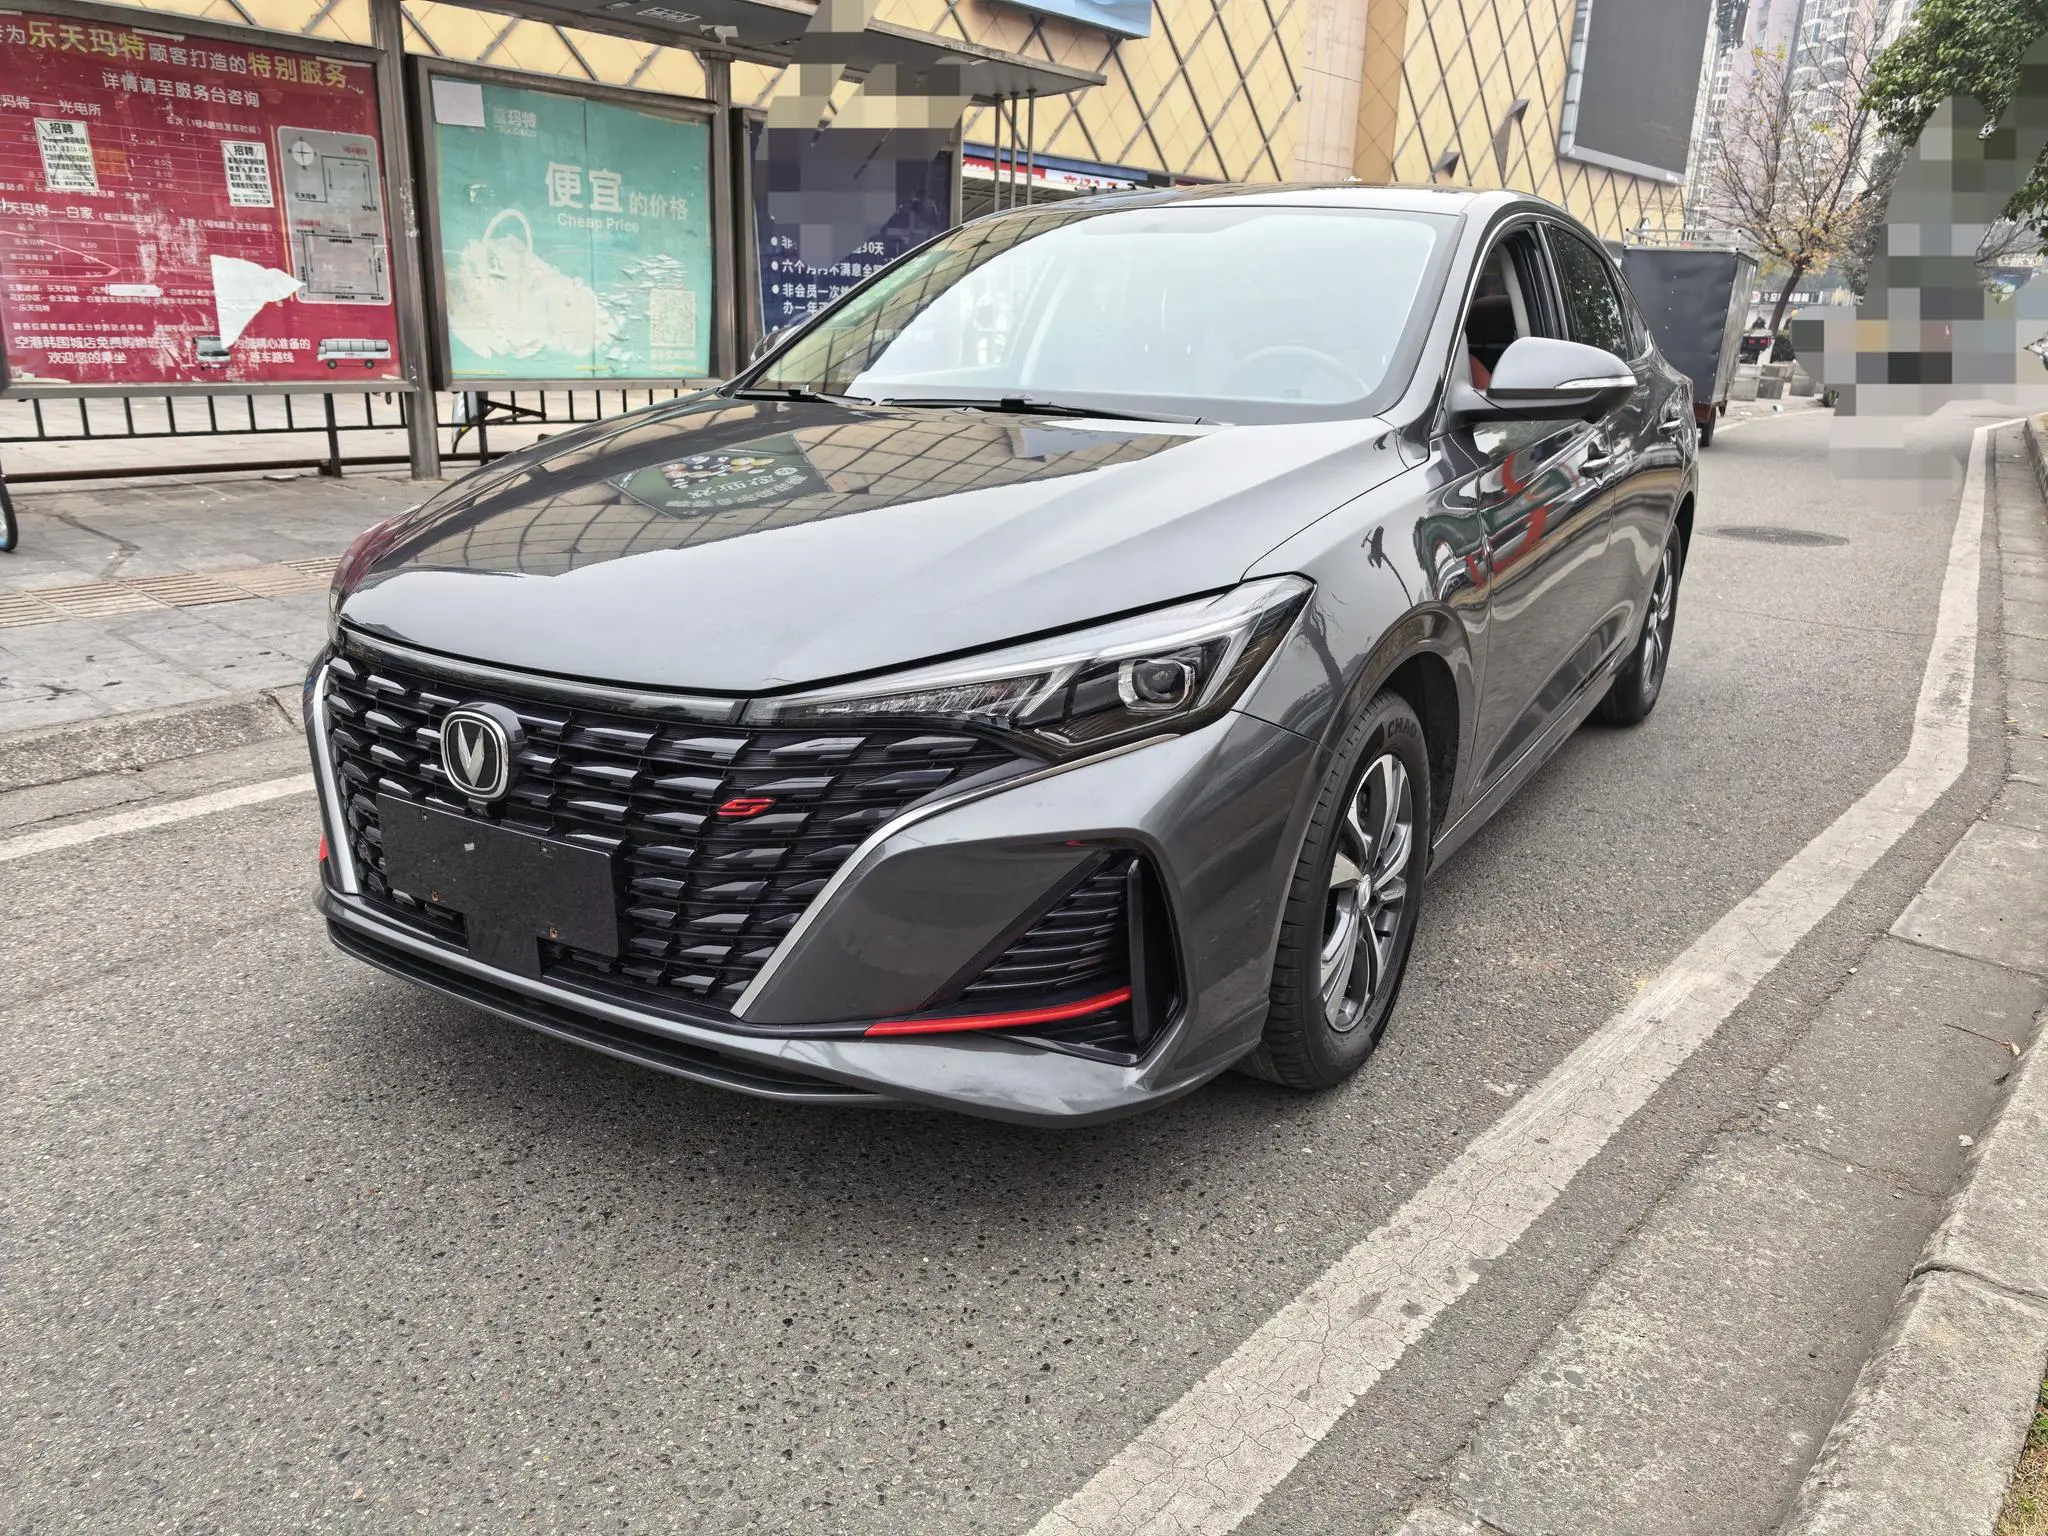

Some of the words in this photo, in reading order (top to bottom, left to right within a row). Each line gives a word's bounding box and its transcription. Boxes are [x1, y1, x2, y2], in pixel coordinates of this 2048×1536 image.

[101, 70, 260, 108] 详情请至服务台咨询
[49, 122, 74, 135] 招聘
[234, 145, 255, 157] 招聘
[545, 160, 689, 222] 便宜的价格
[557, 212, 602, 231] Cheap
[606, 217, 640, 234] Price
[48, 351, 127, 364] 欢迎您的乘坐
